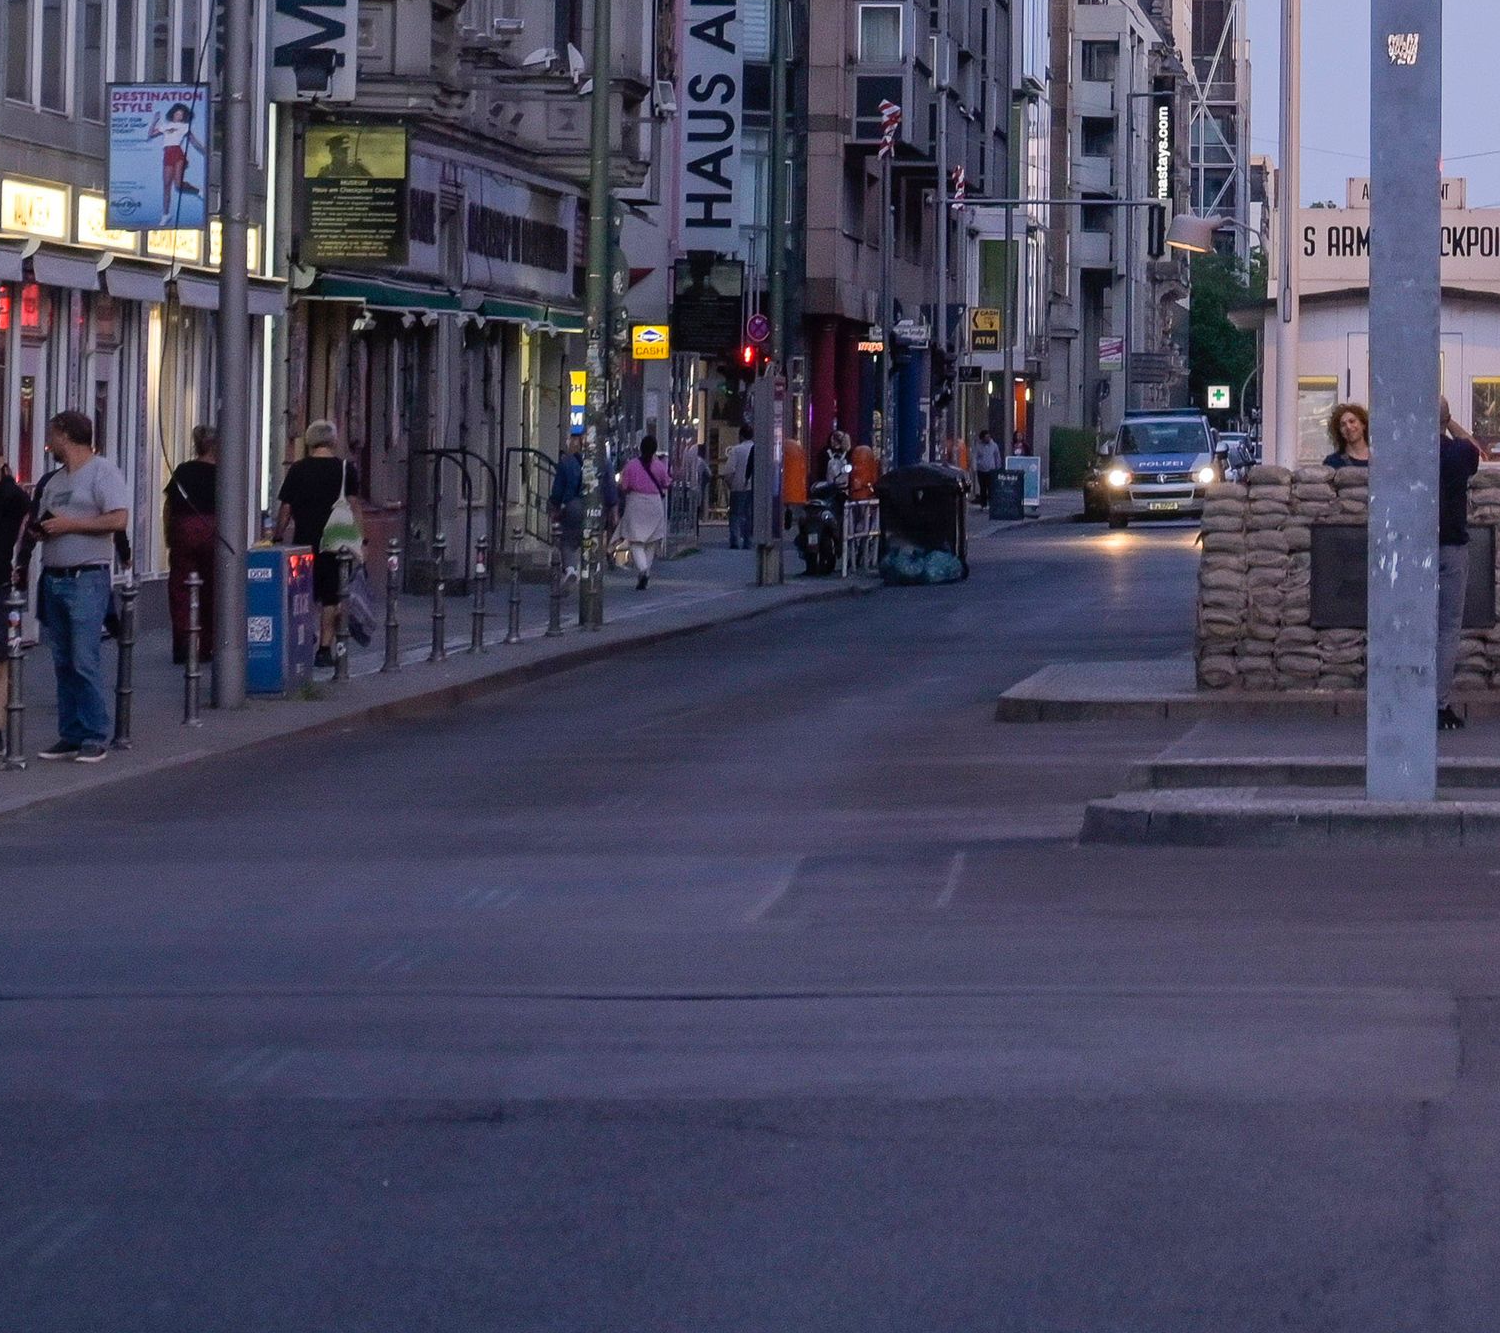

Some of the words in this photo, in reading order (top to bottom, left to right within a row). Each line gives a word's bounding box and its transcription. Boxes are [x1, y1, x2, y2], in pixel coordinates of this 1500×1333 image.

[112, 91, 203, 102] DESTINATION
[112, 102, 153, 112] STYLE
[685, 71, 736, 228] HAUS
[974, 335, 996, 345] ATM
[635, 347, 664, 356] CASH
